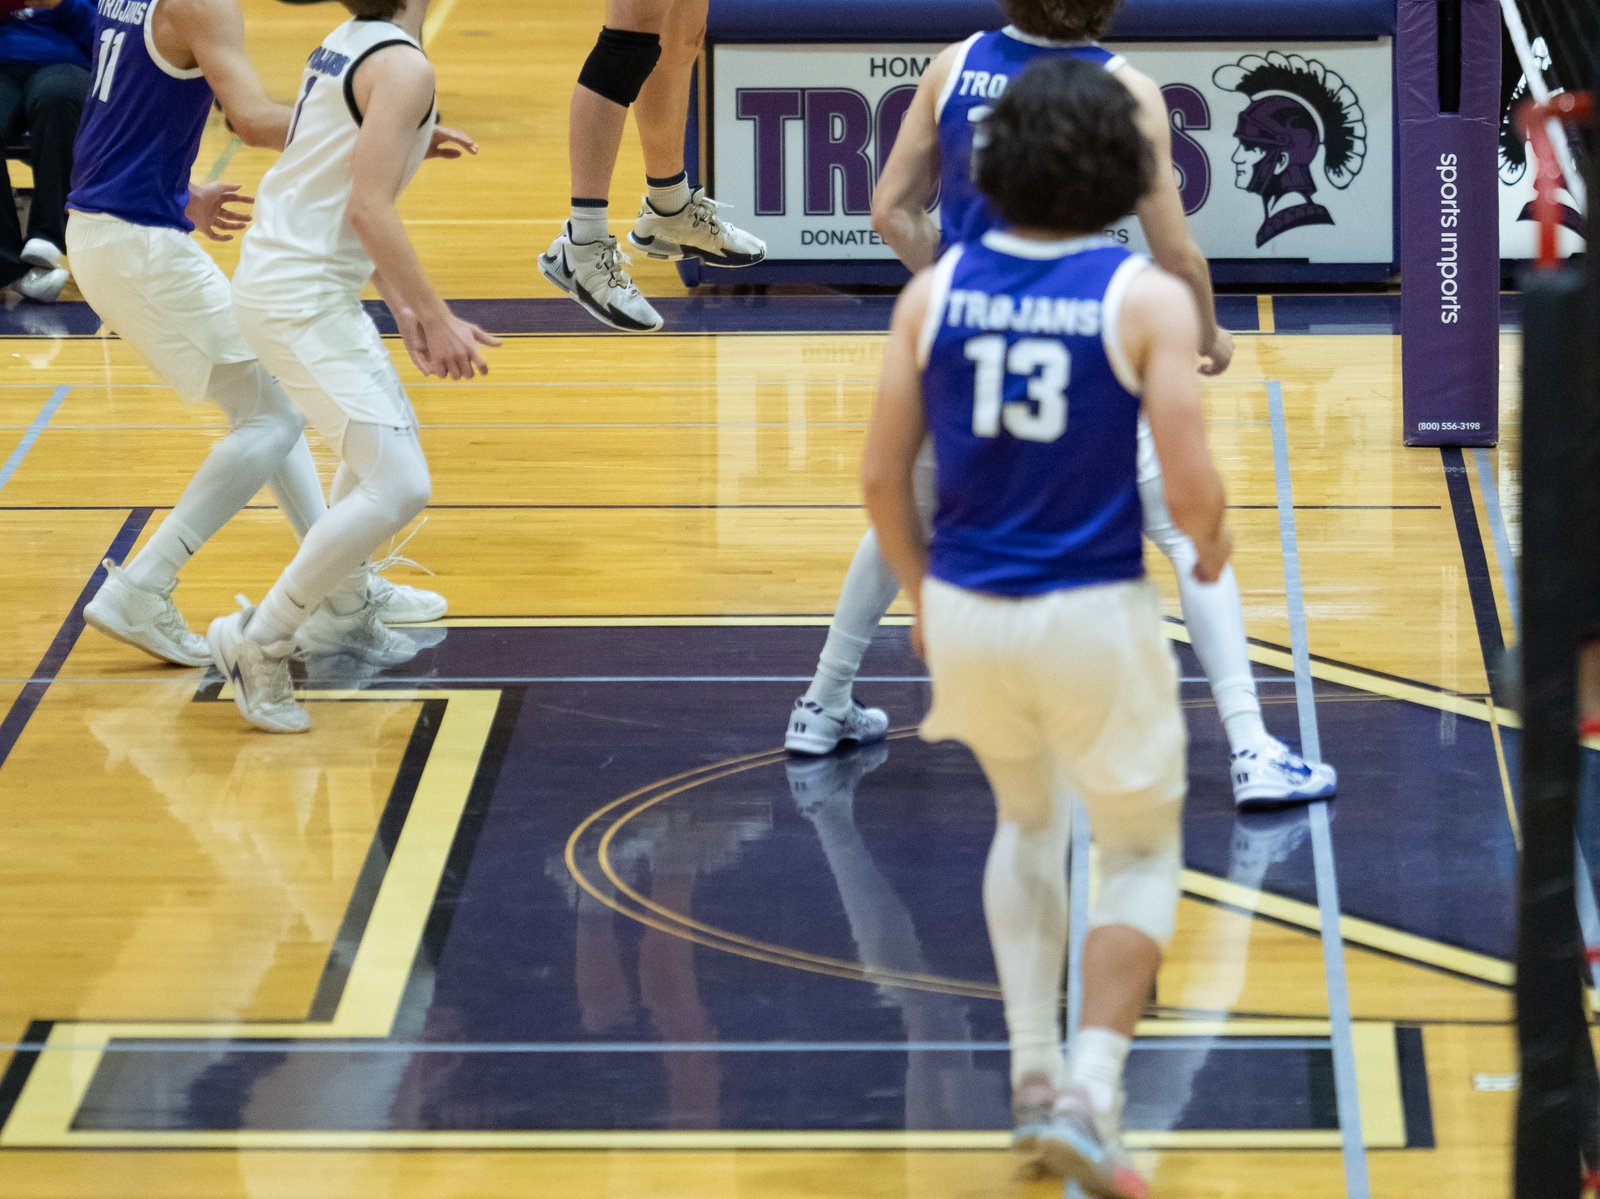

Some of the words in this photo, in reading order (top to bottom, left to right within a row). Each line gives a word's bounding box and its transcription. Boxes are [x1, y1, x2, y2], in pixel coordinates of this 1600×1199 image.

[91, 27, 126, 103] 11
[869, 57, 930, 78] HOM
[1436, 153, 1461, 228] sports
[801, 229, 887, 246] DONATE
[1436, 232, 1462, 324] imports
[948, 288, 1100, 337] TROJANS
[964, 335, 1072, 444] 13
[1417, 422, 1440, 432] (800)
[1441, 422, 1481, 431] 556-3198
